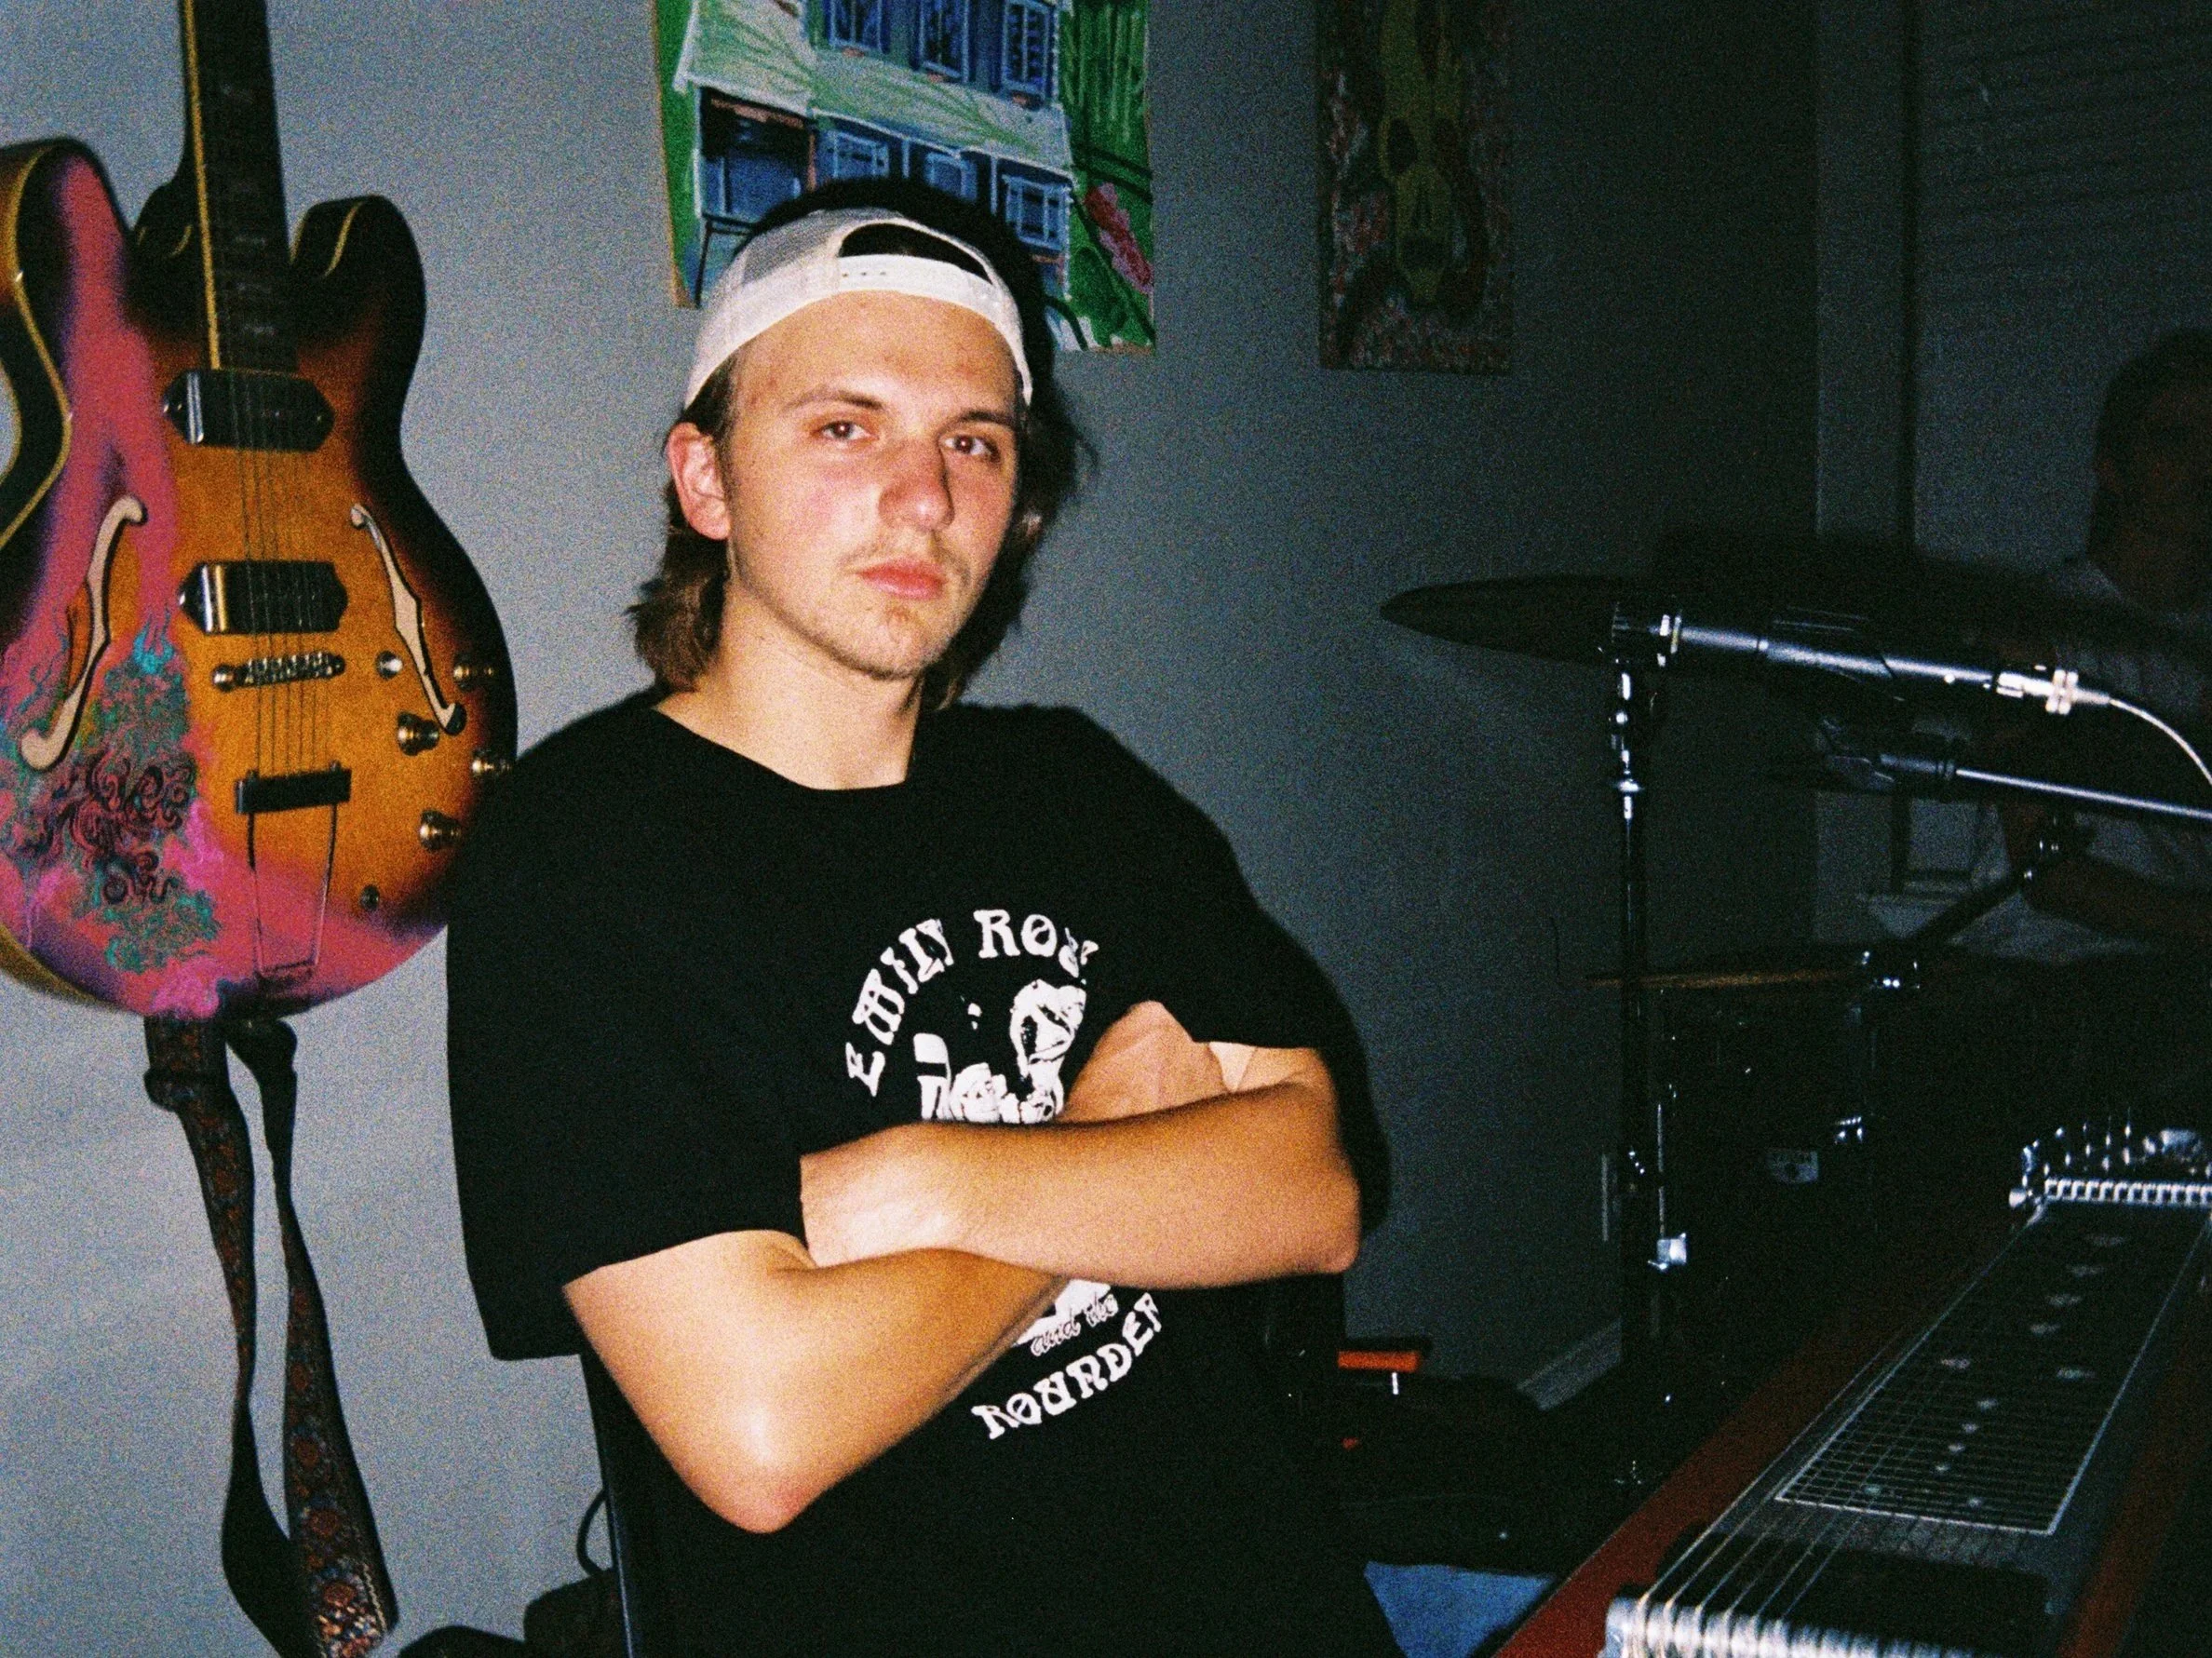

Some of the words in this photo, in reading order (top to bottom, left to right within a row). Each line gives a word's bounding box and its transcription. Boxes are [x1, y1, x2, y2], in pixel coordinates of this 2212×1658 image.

[845, 919, 953, 1097] EMILY
[1031, 1308, 1081, 1355] and
[1083, 1291, 1119, 1328] the
